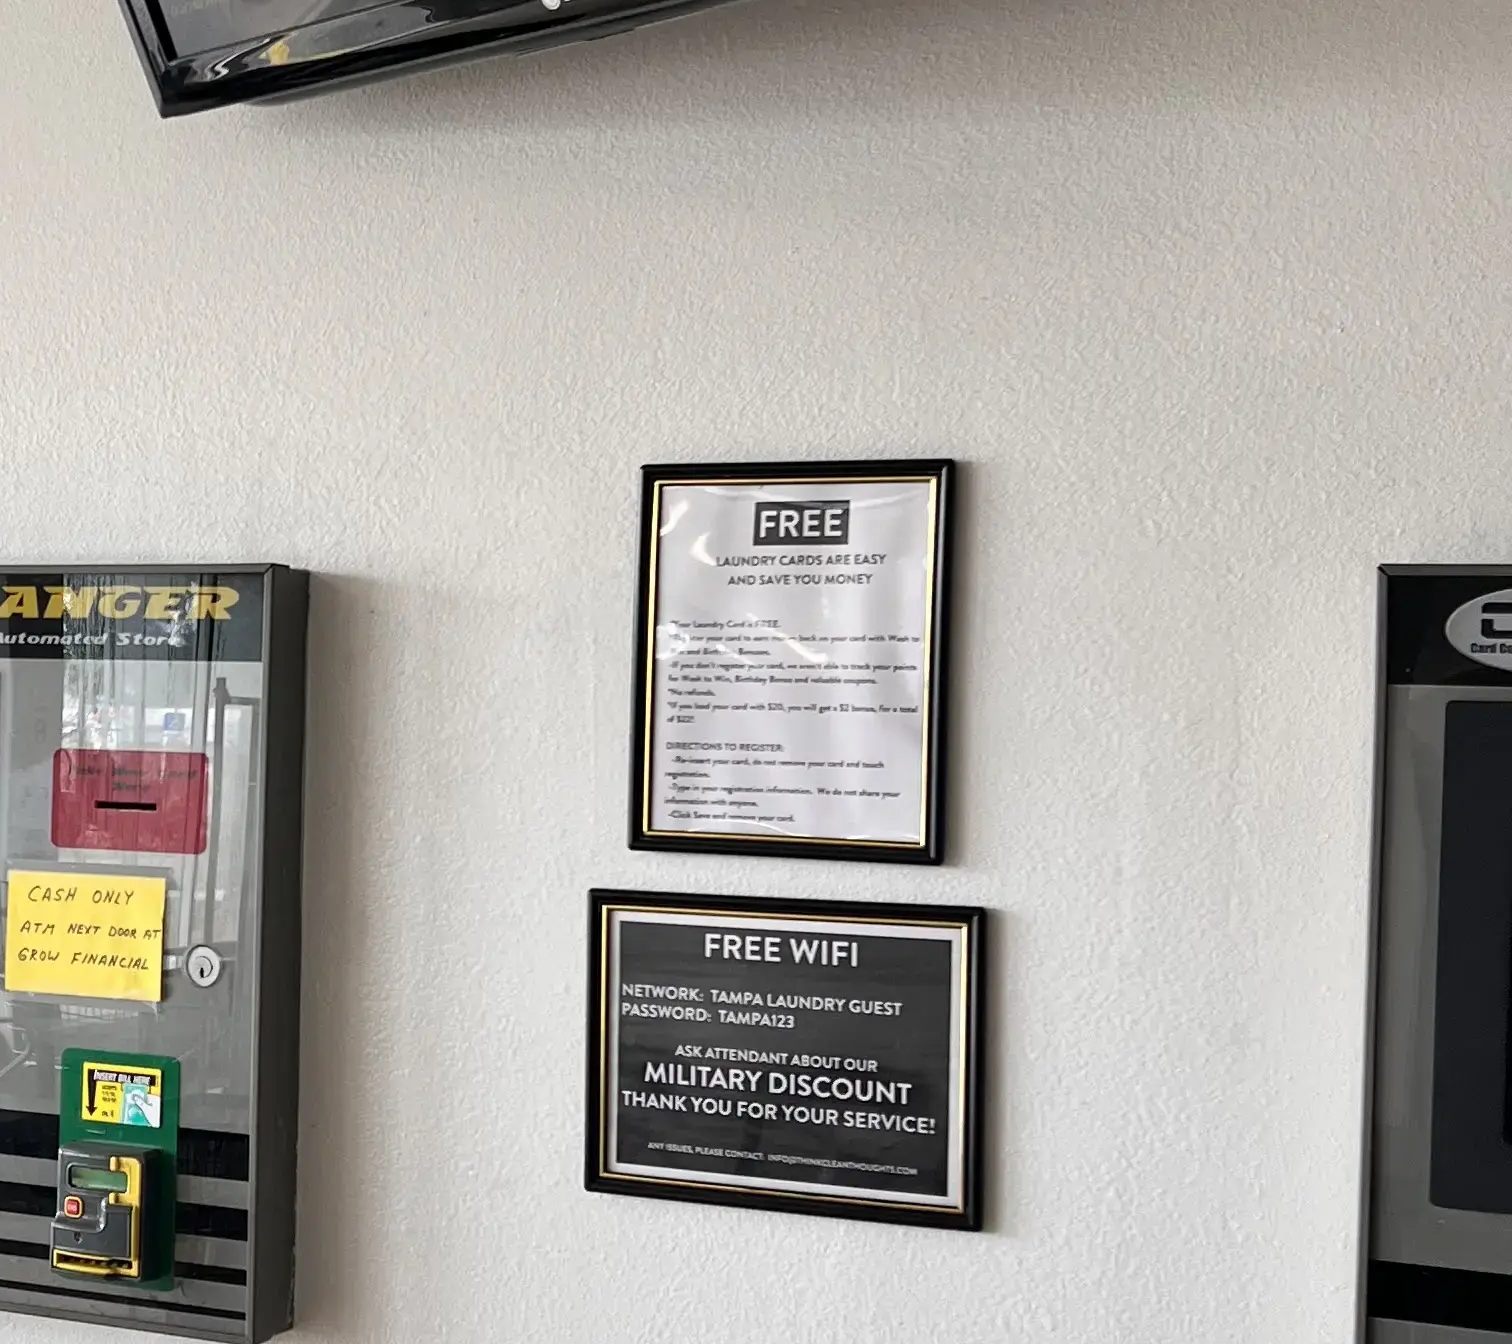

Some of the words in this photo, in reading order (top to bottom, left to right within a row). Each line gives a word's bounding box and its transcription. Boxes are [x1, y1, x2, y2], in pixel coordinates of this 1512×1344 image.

[758, 509, 844, 538] FREE
[716, 555, 776, 567] LAUNDRY
[779, 554, 823, 566] CARDS
[826, 553, 852, 565] ARE
[854, 553, 886, 565] EASY
[727, 575, 757, 586] AND
[759, 574, 792, 585] SAVE
[793, 574, 821, 585] YOU
[824, 573, 873, 585] MONEY
[116, 632, 185, 647] Store
[27, 885, 78, 903] CASH
[91, 890, 135, 905] ONLY
[19, 919, 56, 935] ATM
[67, 923, 101, 936] NEXT
[108, 925, 137, 939] DOOR
[142, 929, 162, 941] AT
[17, 947, 60, 961] GROW
[70, 952, 149, 970] FINANCIAL
[705, 933, 782, 962] FREE
[789, 938, 858, 967] WIFI
[622, 983, 704, 1002] NETWORK:
[710, 989, 764, 1006] TAMPA
[767, 993, 846, 1012] LAUNDRY
[849, 999, 903, 1016] GUEST
[622, 1002, 712, 1022] PASSWORD:
[718, 1009, 795, 1029] TAMPA123
[675, 1044, 702, 1058] ASK
[705, 1047, 788, 1065] ATTENDANT
[790, 1054, 842, 1069] ABOUT
[843, 1058, 878, 1073] OUR
[644, 1061, 763, 1092] MILITARY
[769, 1072, 912, 1105] DISCOUNT
[621, 1090, 687, 1112] THANK
[690, 1096, 732, 1116] YOU
[737, 1101, 777, 1121] FOR
[782, 1105, 839, 1126] YOUR
[842, 1110, 936, 1135] SERVICE!
